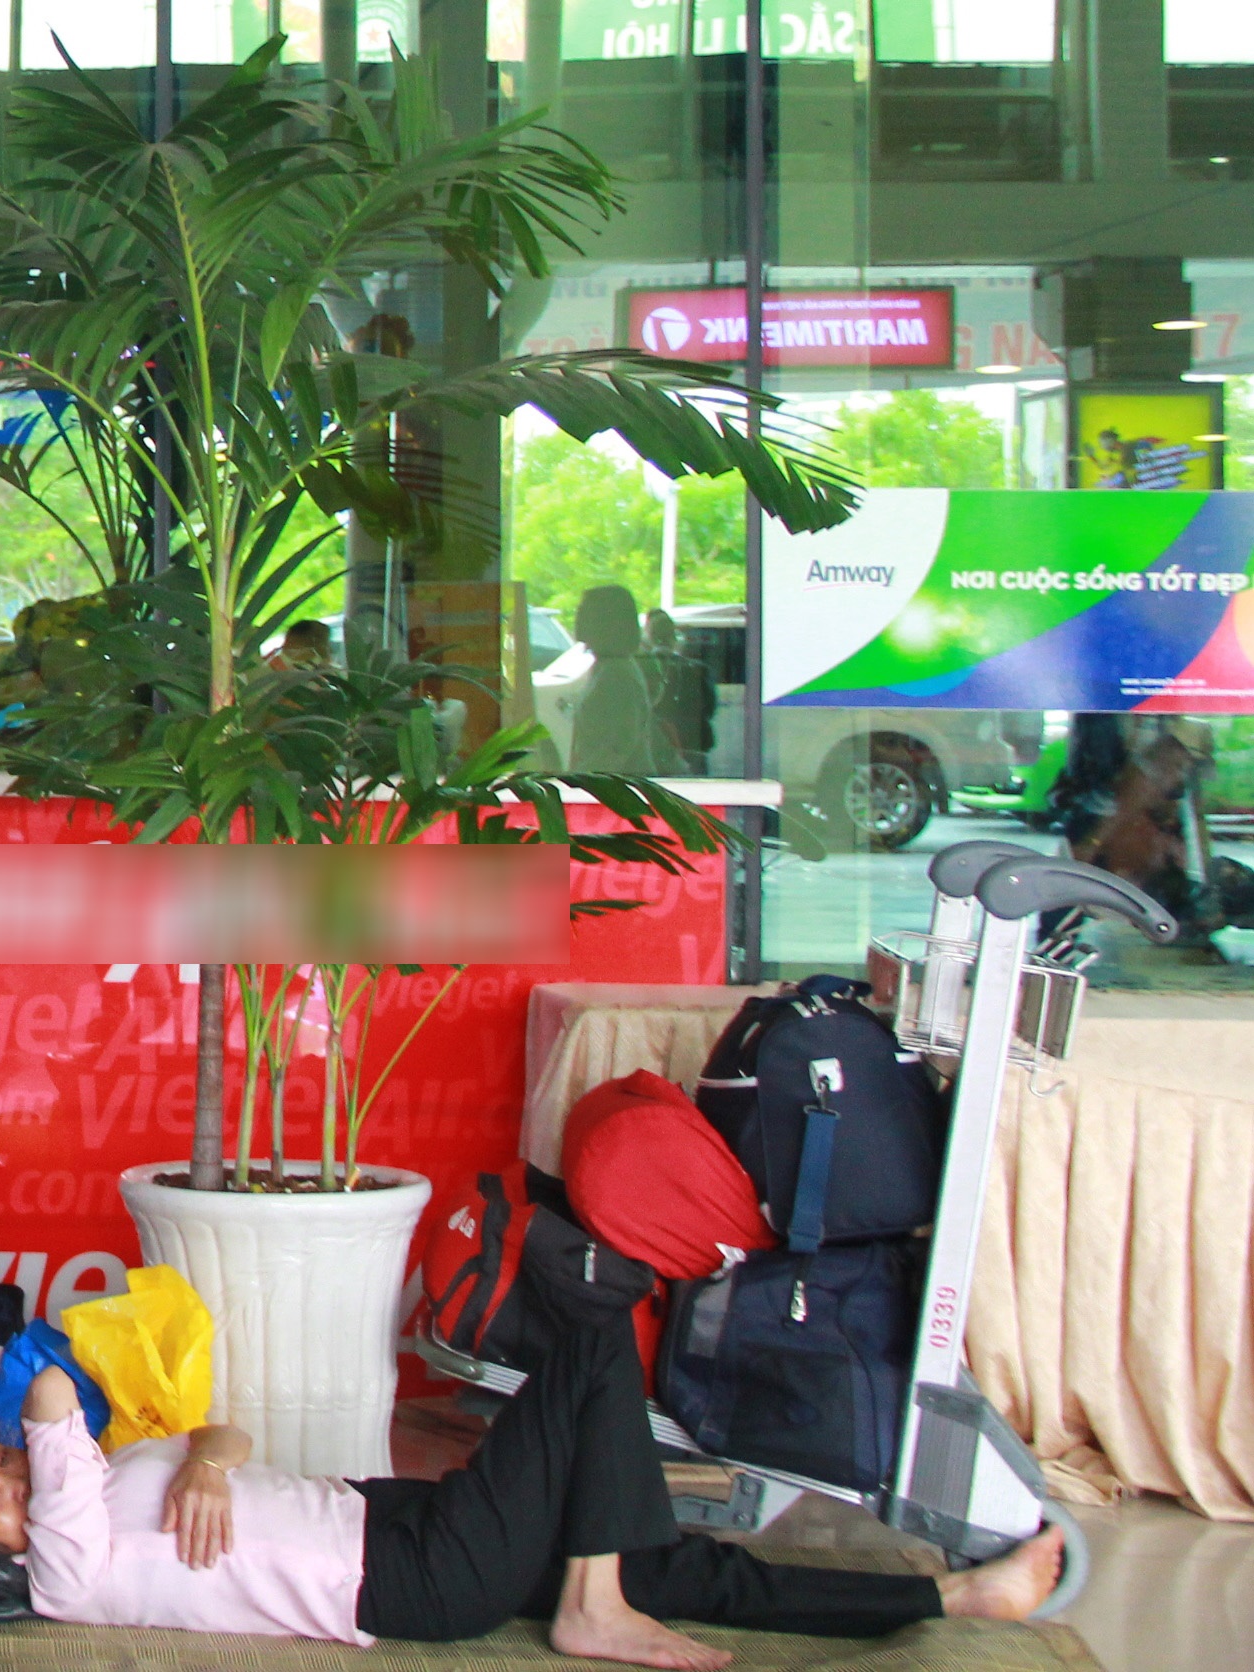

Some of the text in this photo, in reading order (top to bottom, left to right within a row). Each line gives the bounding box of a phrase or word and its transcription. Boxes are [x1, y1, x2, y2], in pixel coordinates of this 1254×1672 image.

[806, 559, 895, 587] Amway
[999, 565, 1070, 594] CUỘC
[1073, 563, 1144, 591] SỐNG
[1146, 563, 1197, 592] TỐT
[1199, 572, 1249, 597] ĐẸP
[929, 1285, 957, 1349] 0339
